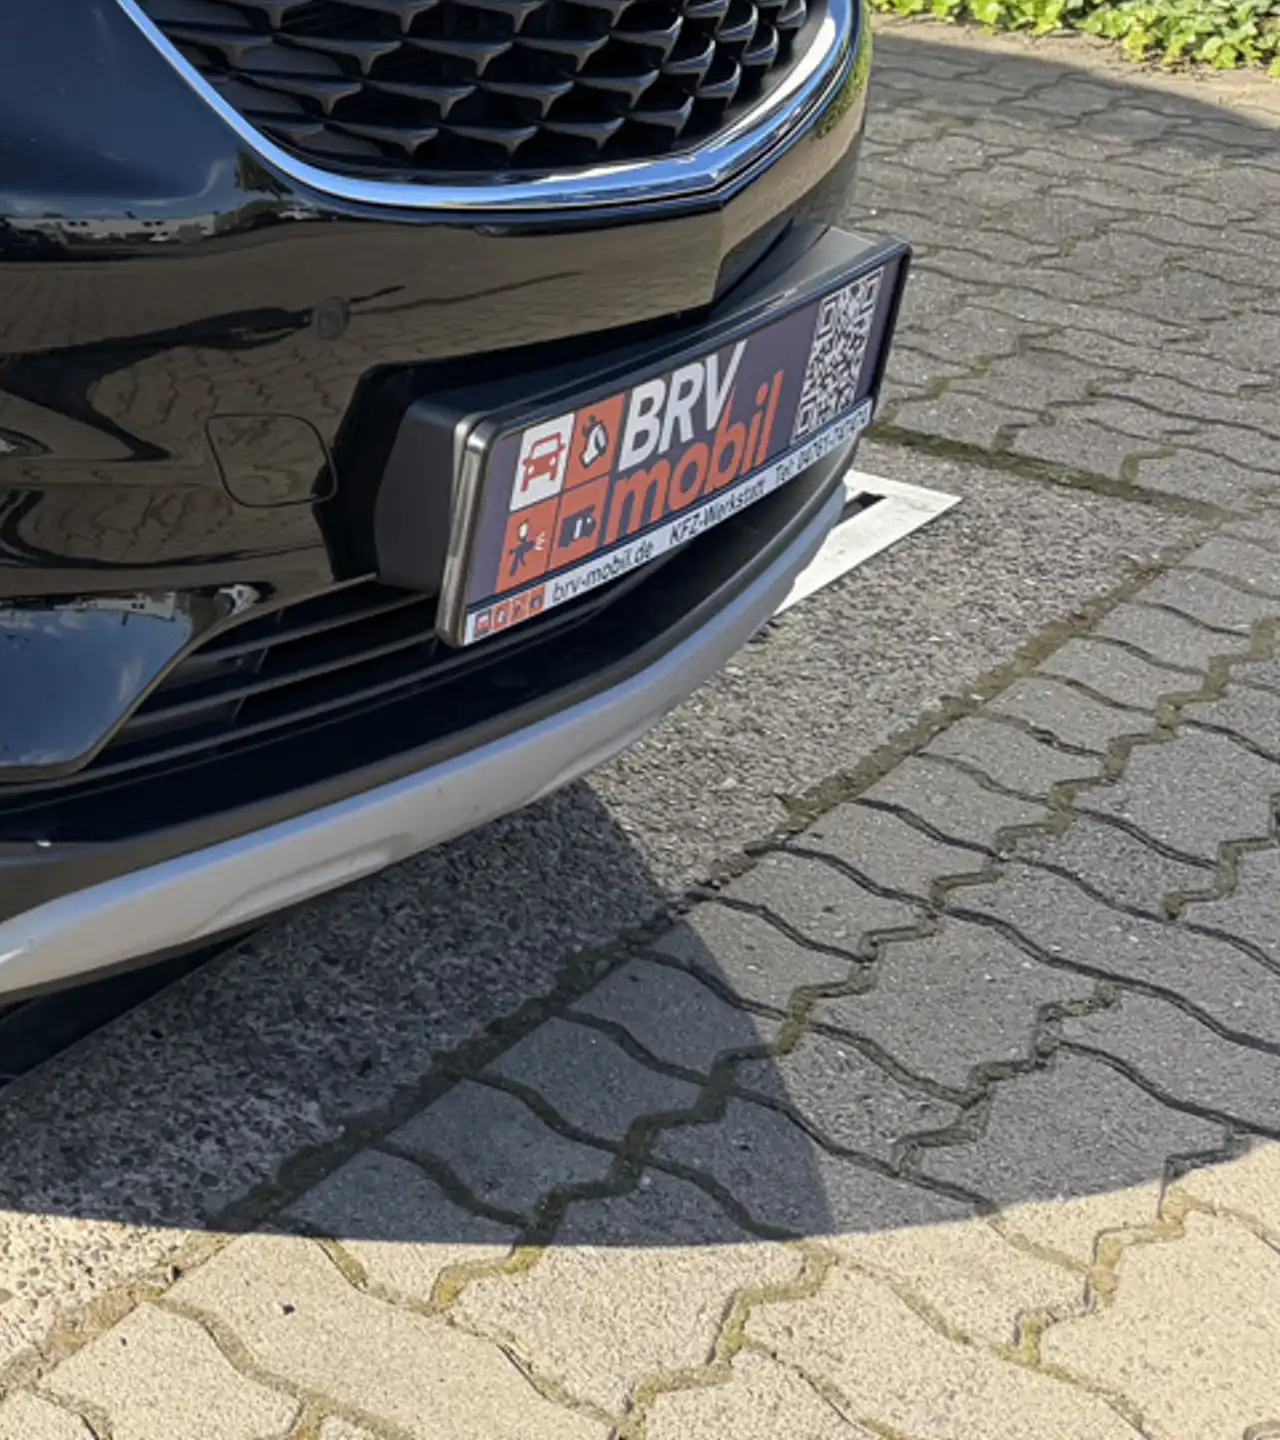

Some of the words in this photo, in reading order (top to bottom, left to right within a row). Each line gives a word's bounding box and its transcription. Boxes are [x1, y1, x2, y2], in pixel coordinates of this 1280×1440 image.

[603, 368, 785, 545] mobil
[618, 339, 748, 472] BRV
[551, 539, 655, 602] brv-mobil.de
[668, 478, 765, 544] KFZ-Werkstatt
